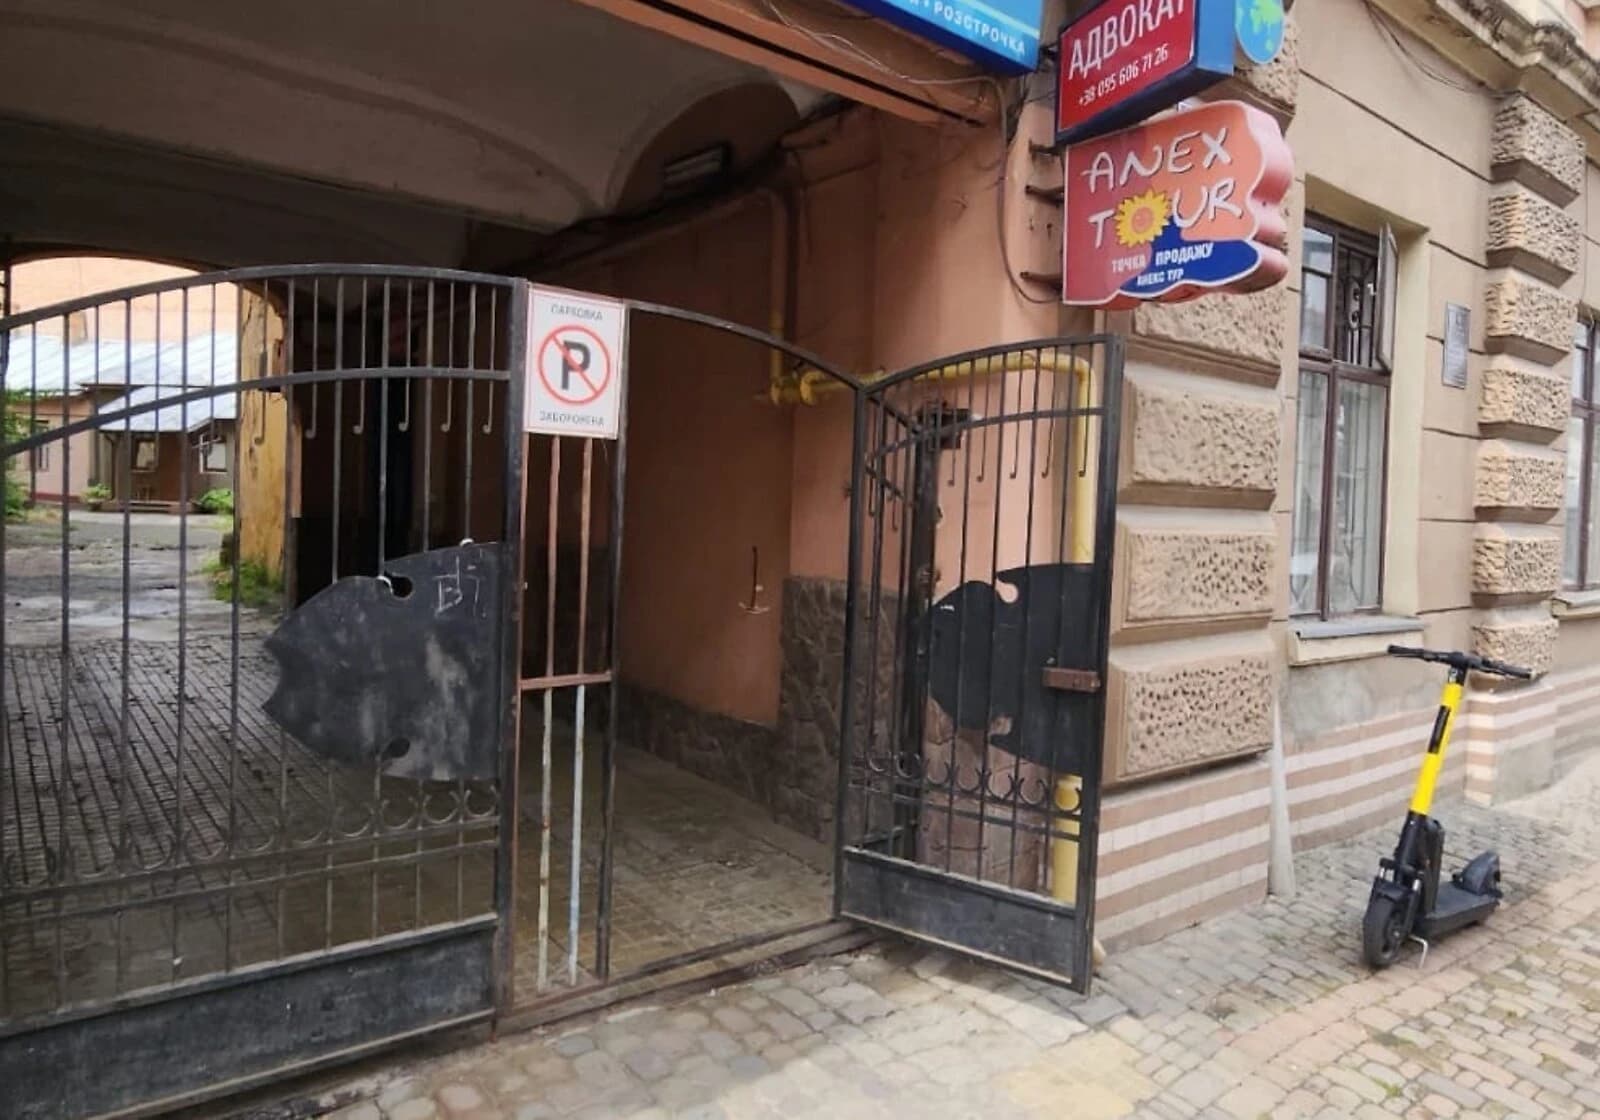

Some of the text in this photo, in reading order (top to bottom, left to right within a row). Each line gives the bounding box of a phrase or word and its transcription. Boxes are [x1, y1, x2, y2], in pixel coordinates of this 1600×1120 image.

[934, 1, 1026, 55] РОЗСТРОЧКА
[1078, 43, 1169, 106] +38 095 606 71 26
[1081, 127, 1232, 193] ANEX
[1111, 242, 1214, 273] ТОЧКА ПРОДАЖУ
[1167, 268, 1184, 282] ТУР
